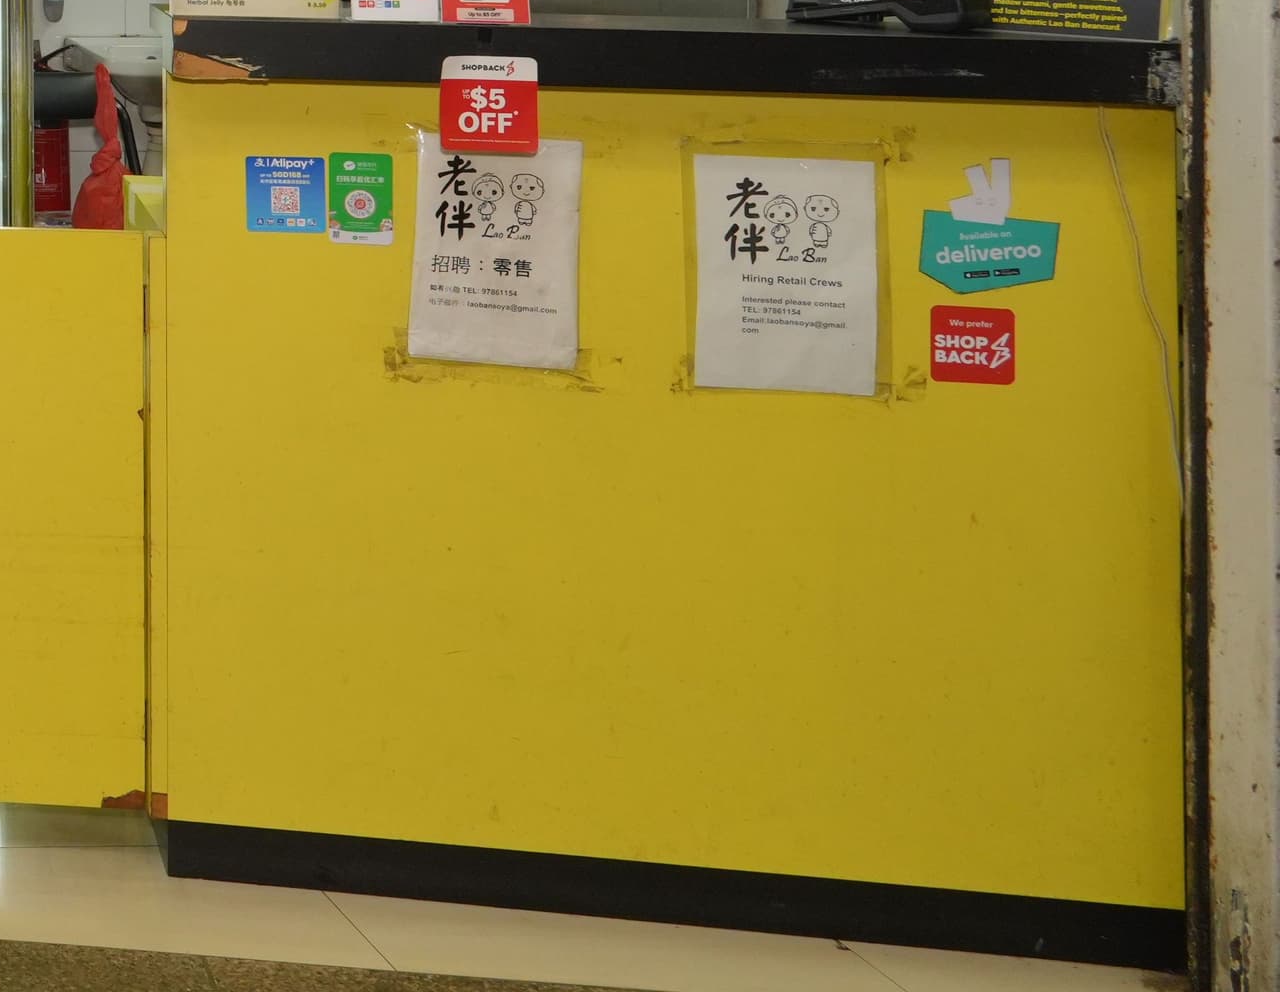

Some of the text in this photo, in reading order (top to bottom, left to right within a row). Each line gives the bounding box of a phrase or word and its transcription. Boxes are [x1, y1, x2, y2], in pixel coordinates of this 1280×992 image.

[461, 64, 506, 72] SHOPBACK
[470, 85, 506, 113] $5
[435, 155, 477, 241] 老伴
[724, 177, 770, 265] 老伴
[481, 223, 504, 238] Lao
[776, 246, 828, 263] Lao Ban
[935, 244, 1042, 265] deliveroo
[742, 273, 843, 288] Hiring Retail Crews
[742, 295, 846, 310] Interested please contact
[949, 319, 994, 329] We prefer
[934, 334, 989, 350] SHOP
[935, 349, 989, 366] BACK
